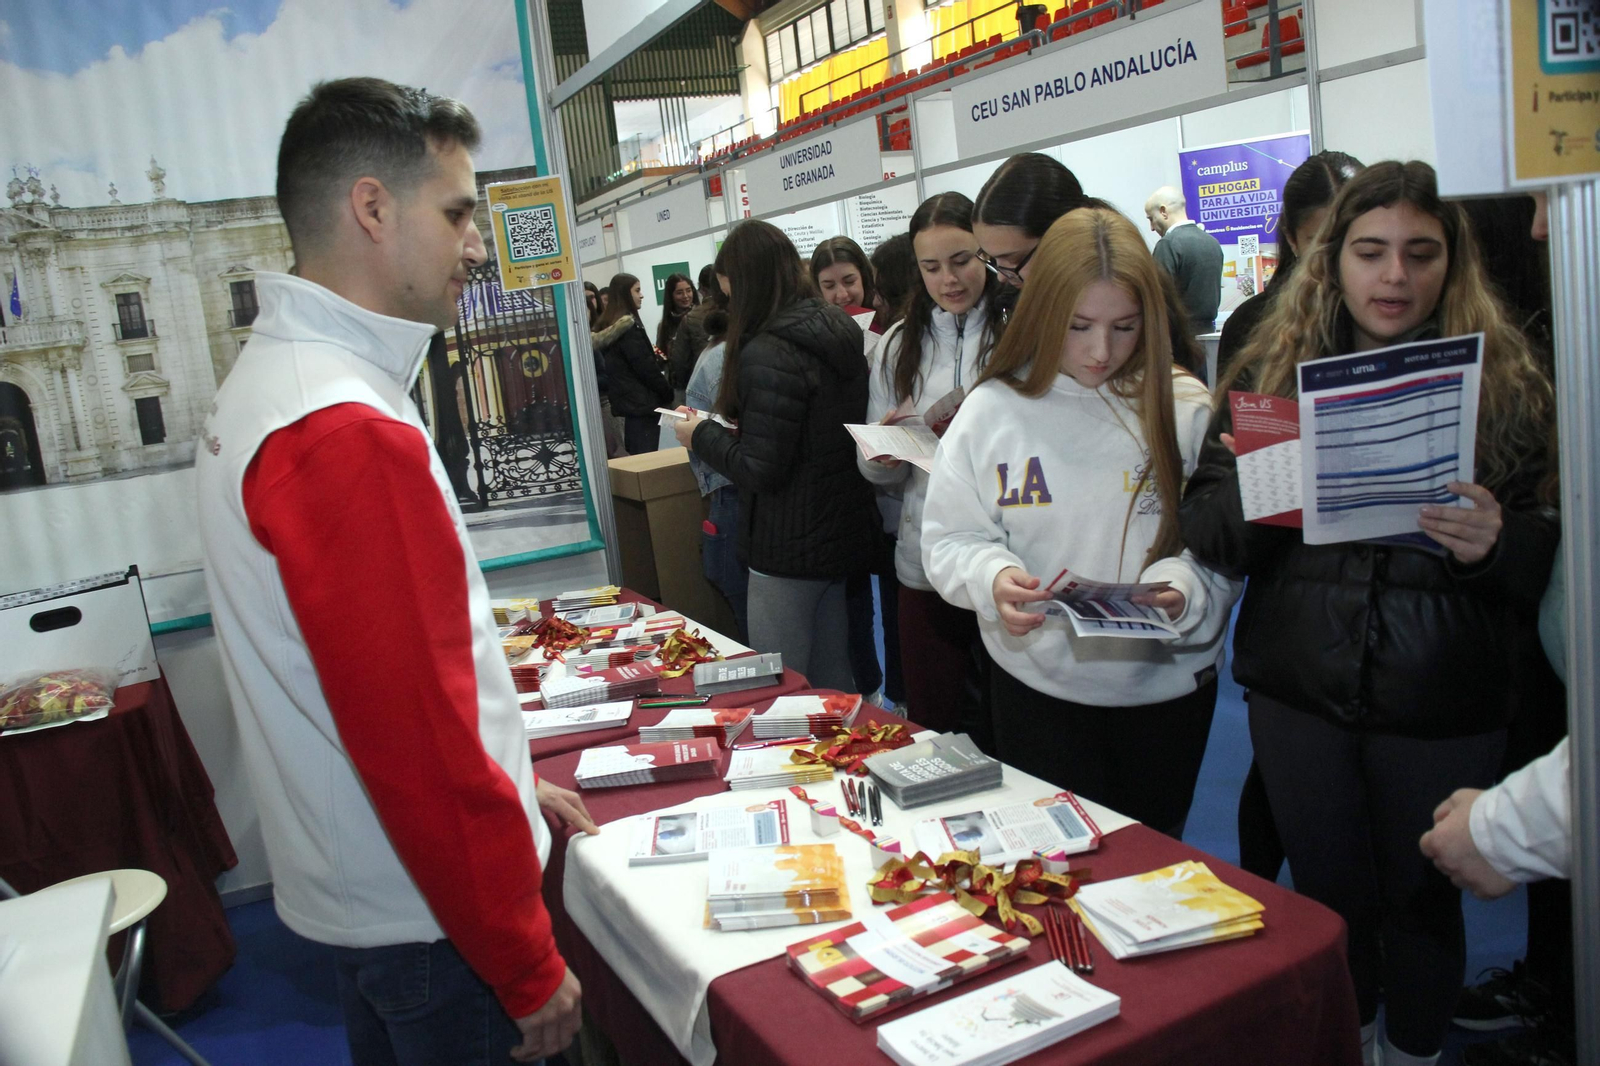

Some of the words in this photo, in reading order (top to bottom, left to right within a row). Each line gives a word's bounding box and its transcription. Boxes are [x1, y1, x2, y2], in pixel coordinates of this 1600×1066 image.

[971, 99, 998, 122] CEU
[1002, 88, 1030, 112] SAN
[1034, 72, 1086, 103] PABLO
[1090, 38, 1198, 88] ANDALUCÍA
[780, 140, 832, 169] UNIVERSIDAD
[1197, 160, 1248, 176] camplus
[782, 176, 794, 191] DE
[795, 164, 835, 188] GRANADA
[1201, 185, 1215, 196] TU
[1218, 180, 1257, 193] HOGAR
[1202, 197, 1230, 208] PARA
[1232, 195, 1246, 204] LA
[1248, 191, 1274, 202] VIDA
[656, 209, 670, 222] UNED
[1404, 354, 1429, 364] NOTAS
[996, 456, 1052, 508] LA
